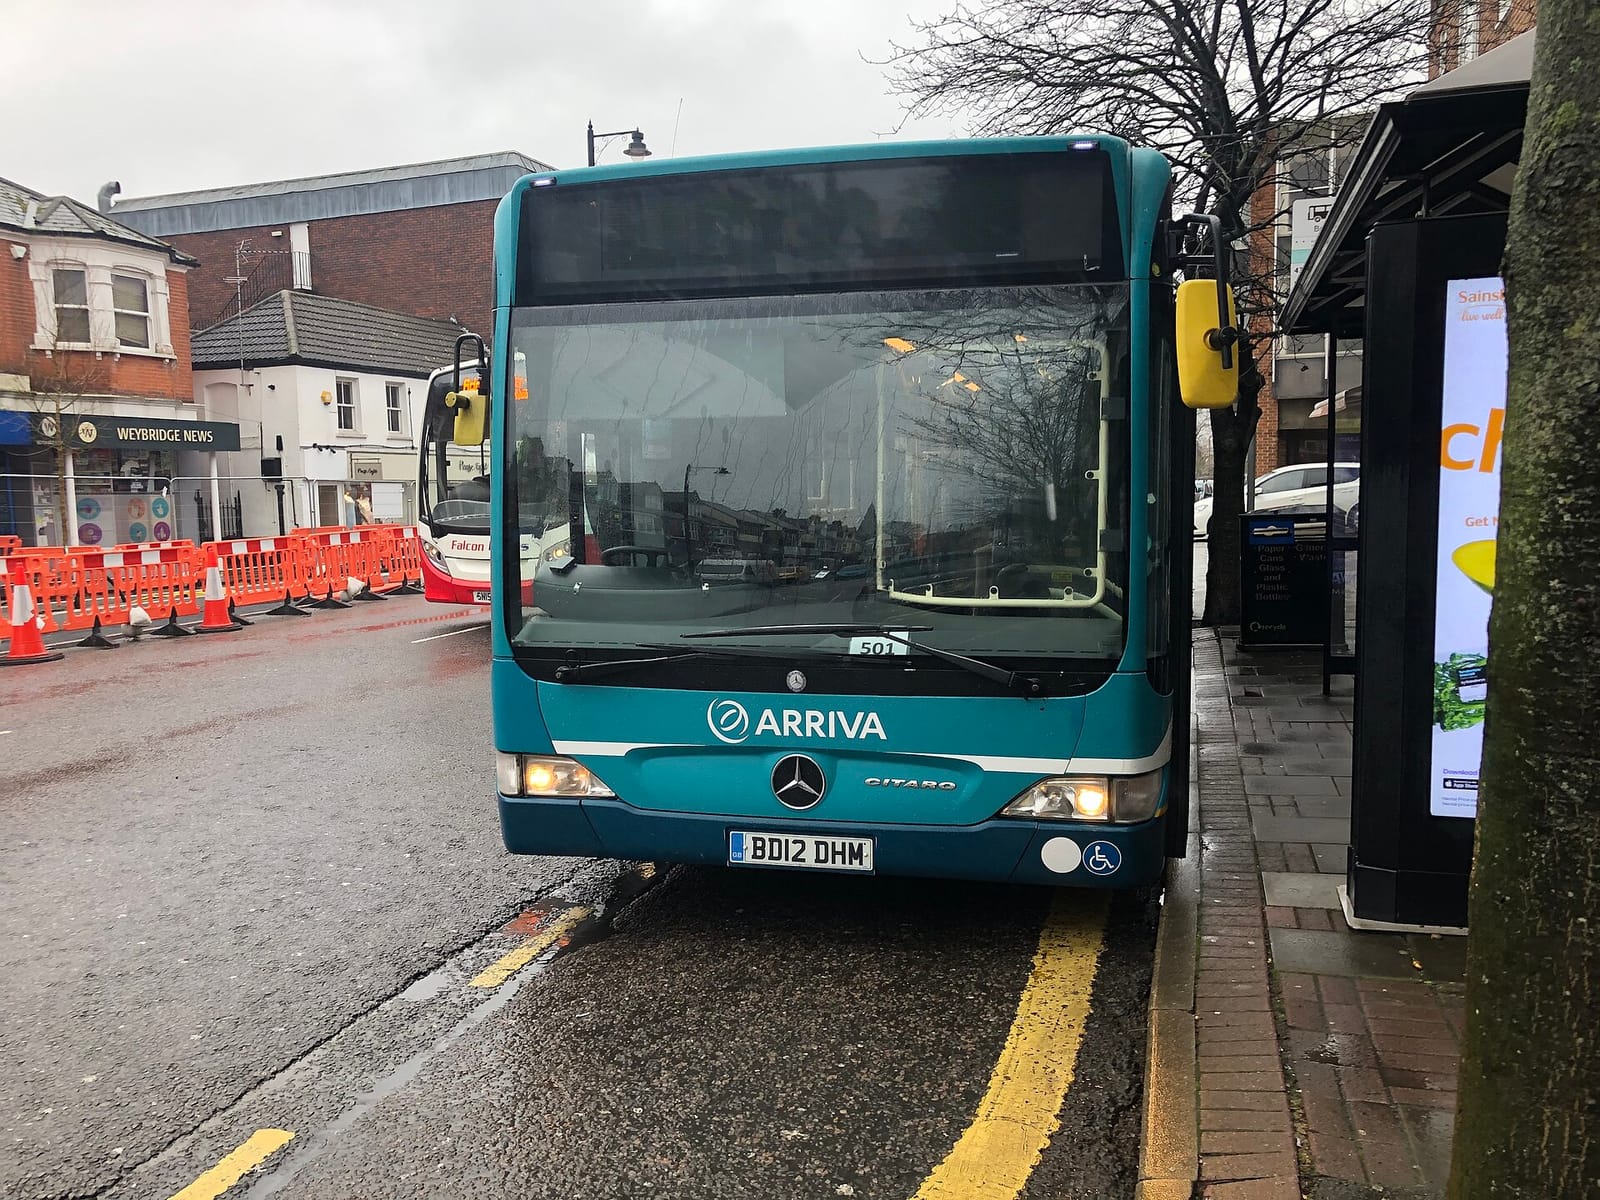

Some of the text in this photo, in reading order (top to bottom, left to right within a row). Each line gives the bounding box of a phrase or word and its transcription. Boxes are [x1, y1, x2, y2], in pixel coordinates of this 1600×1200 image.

[117, 427, 213, 442] WEYBRIDGE NEWS
[1465, 517, 1488, 527] Get
[451, 540, 485, 551] Falcon
[1258, 564, 1285, 572] Glass
[860, 642, 895, 655] 501
[755, 708, 887, 740] ARRIVA
[864, 776, 956, 791] CITARO
[751, 836, 864, 866] BD12 DHM
